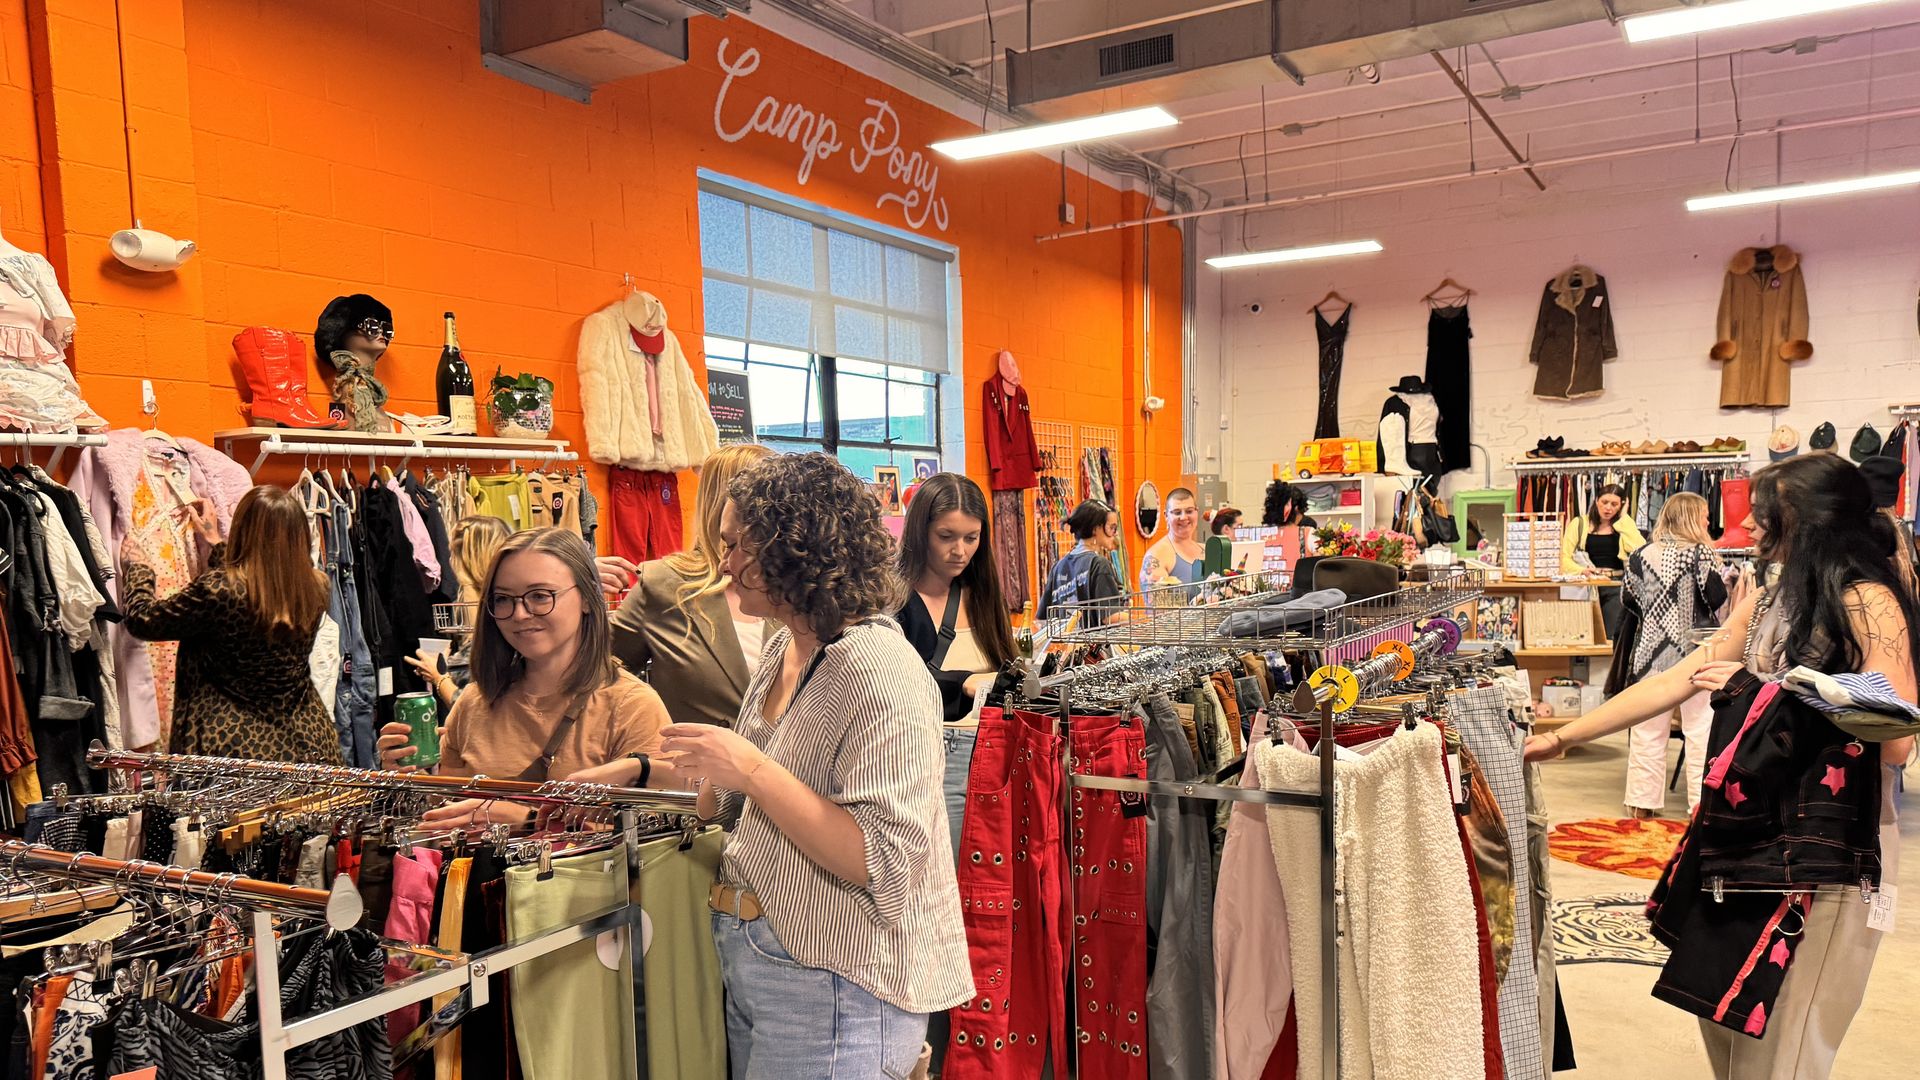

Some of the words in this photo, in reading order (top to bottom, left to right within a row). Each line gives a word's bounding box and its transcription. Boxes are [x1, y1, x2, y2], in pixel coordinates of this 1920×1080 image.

[714, 37, 842, 185] Camp
[850, 97, 949, 231] Pony
[725, 382, 745, 400] SELL
[1392, 643, 1403, 654] XL
[1401, 660, 1411, 671] XL
[1318, 672, 1328, 680] L
[1342, 675, 1350, 684] L
